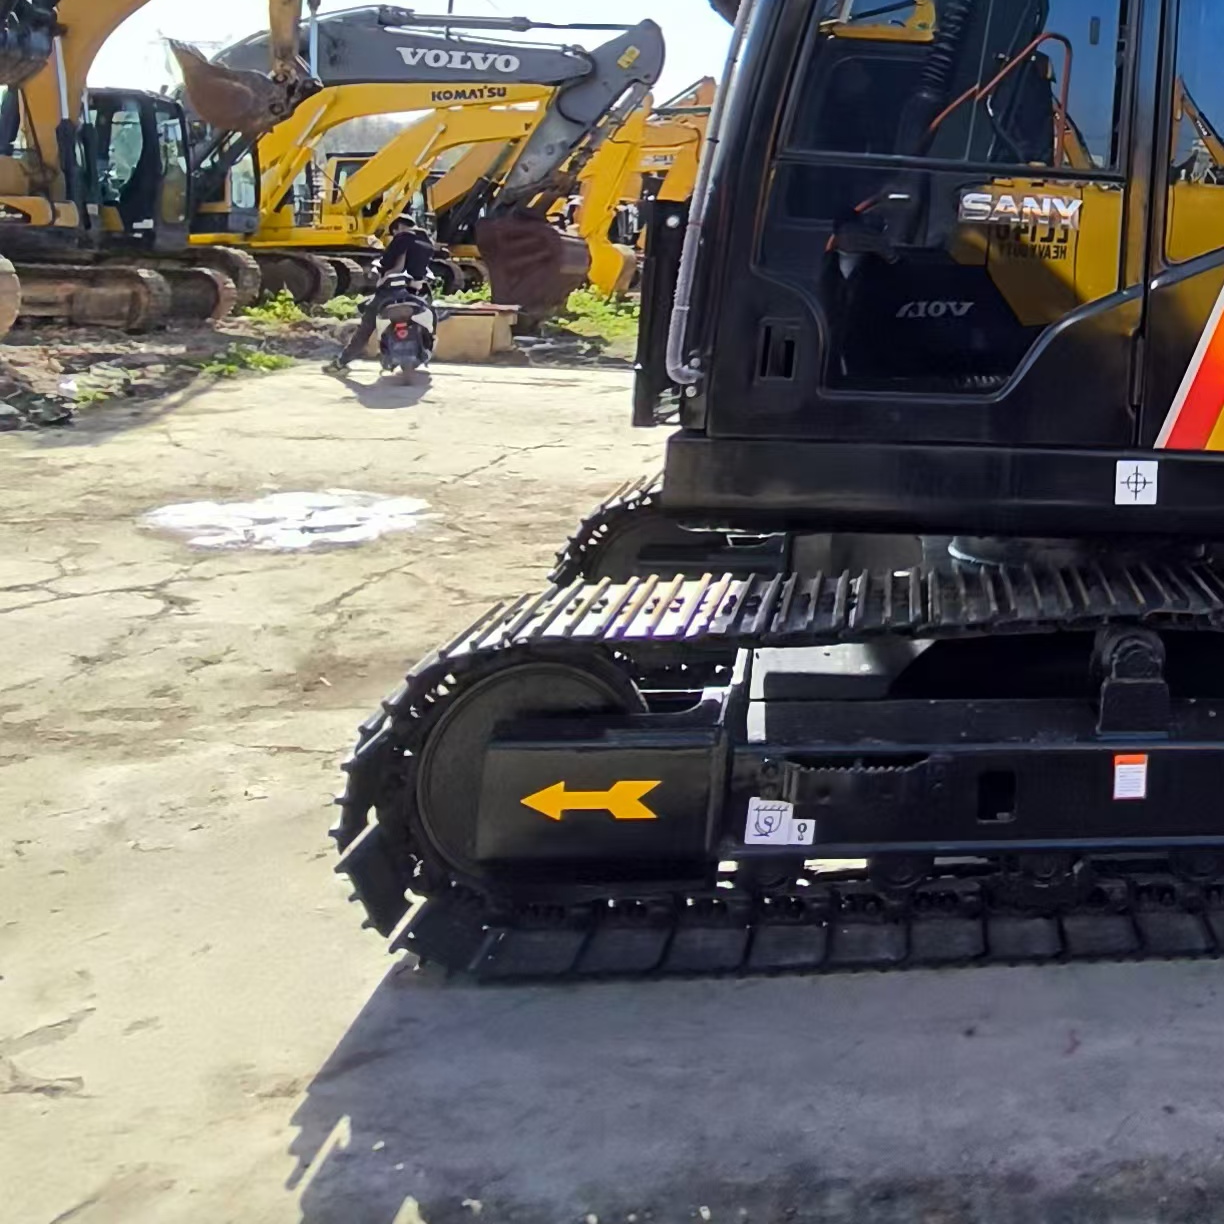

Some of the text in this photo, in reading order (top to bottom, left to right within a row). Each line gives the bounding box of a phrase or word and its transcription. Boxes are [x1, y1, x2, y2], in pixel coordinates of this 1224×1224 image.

[396, 46, 520, 73] VOLVO
[431, 85, 507, 102] KOMATSU
[962, 192, 1083, 225] SANY
